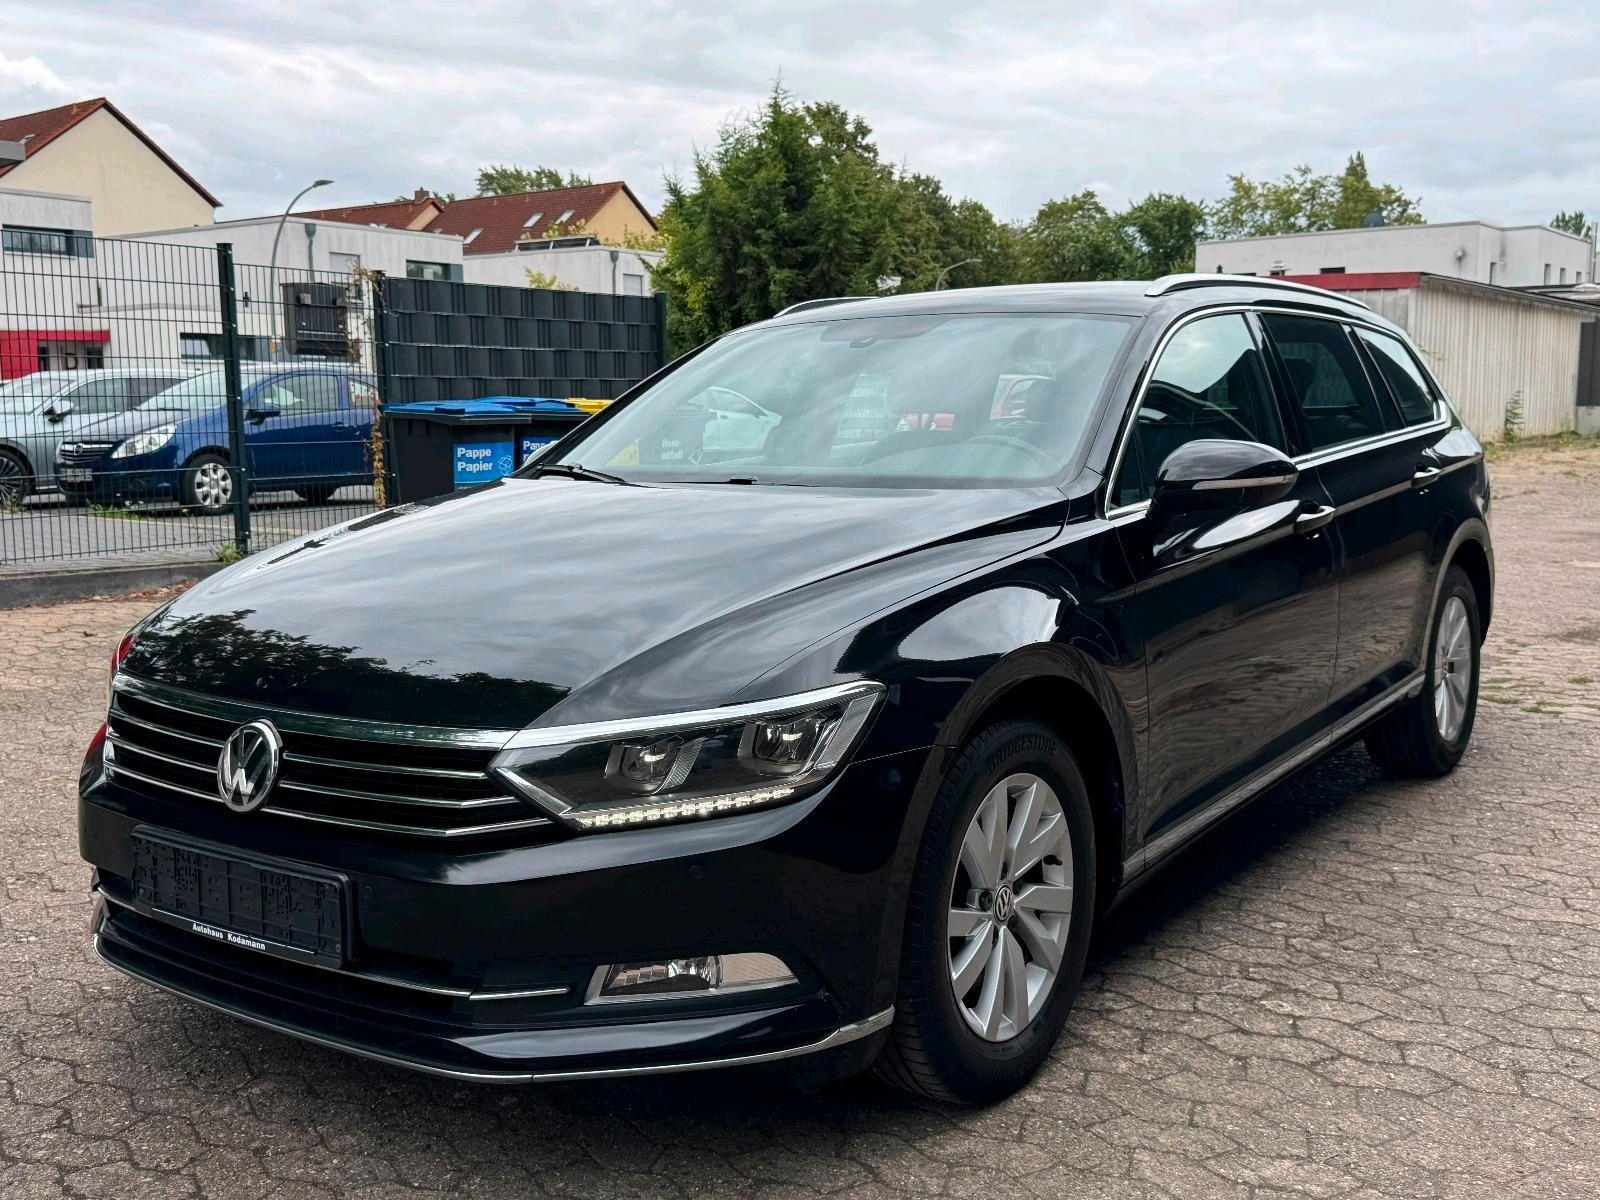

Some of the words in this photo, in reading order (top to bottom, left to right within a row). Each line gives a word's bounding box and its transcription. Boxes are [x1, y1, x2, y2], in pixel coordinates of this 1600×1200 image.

[457, 447, 492, 459] Pappe
[457, 461, 493, 473] Papier
[987, 734, 1057, 773] BRIDGESTONE
[192, 922, 224, 939] Autohaus
[227, 932, 266, 950] Kodamann
